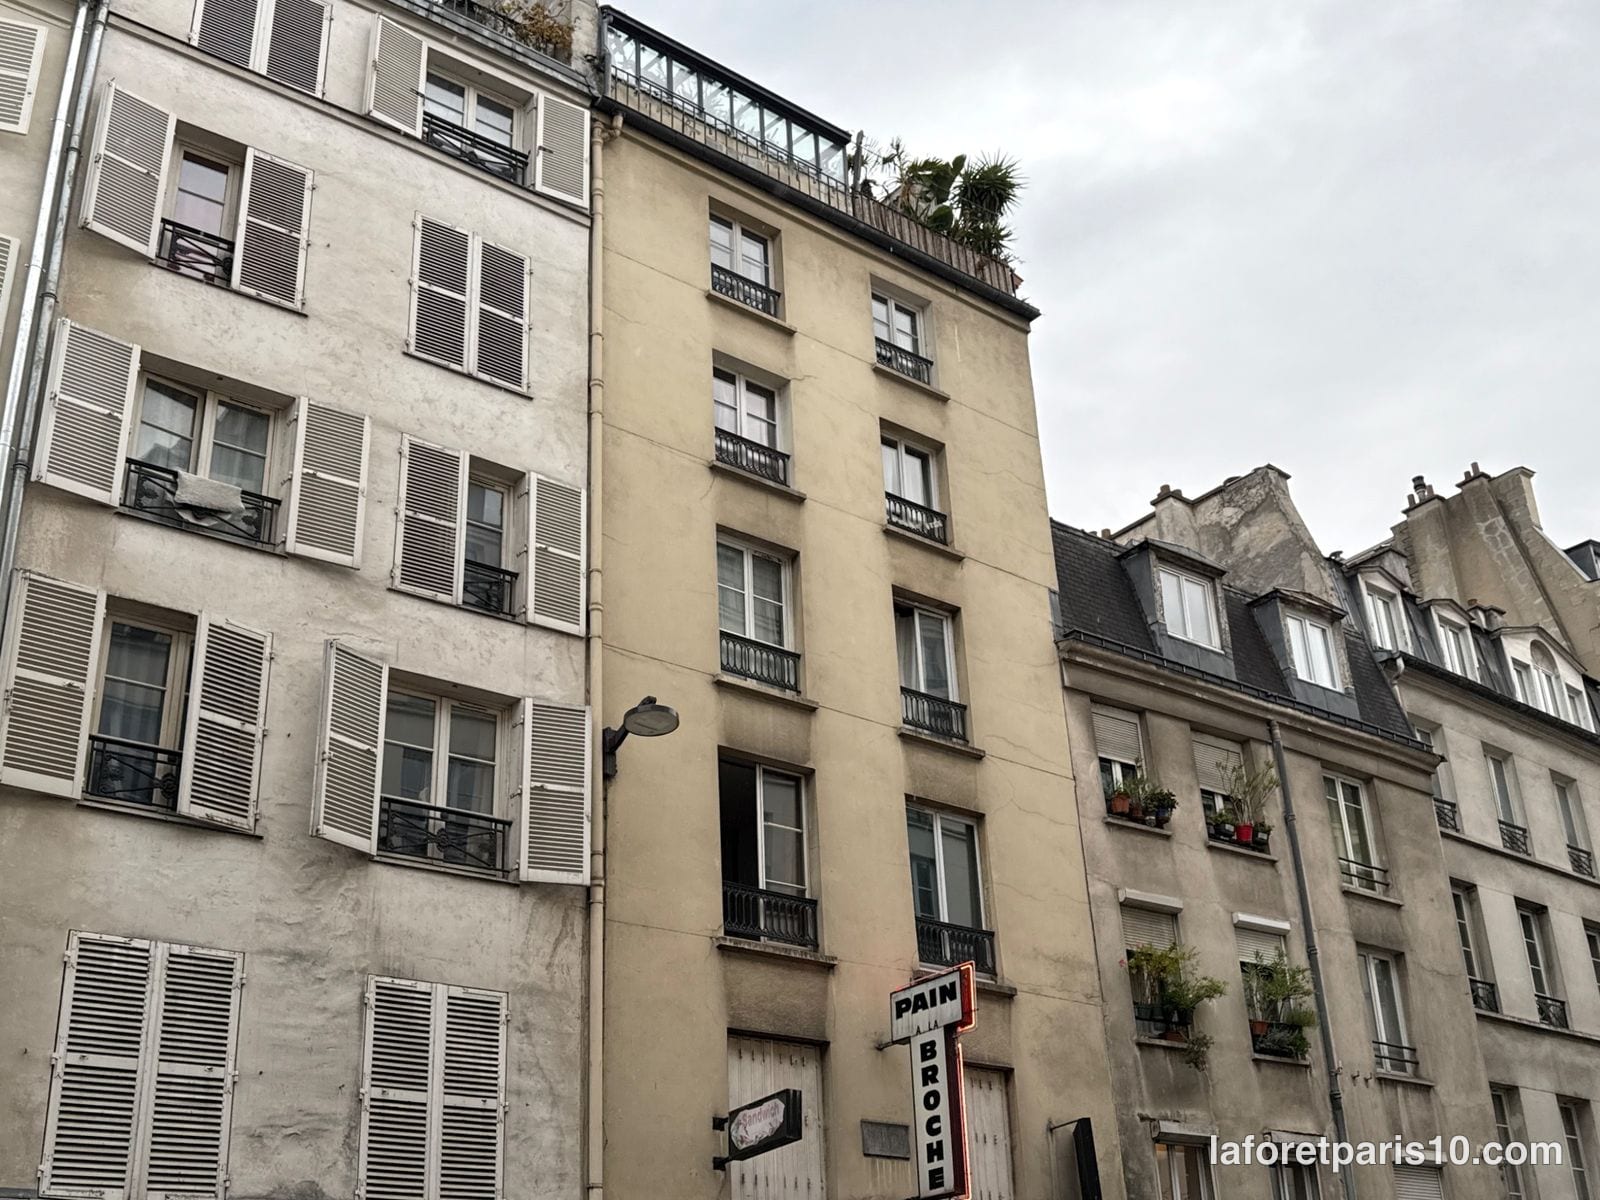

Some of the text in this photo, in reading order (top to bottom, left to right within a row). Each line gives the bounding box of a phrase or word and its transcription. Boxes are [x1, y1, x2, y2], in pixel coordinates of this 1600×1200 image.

[895, 980, 957, 1020] PAIN
[928, 1019, 939, 1031] LA
[919, 1039, 945, 1191] BROCHE
